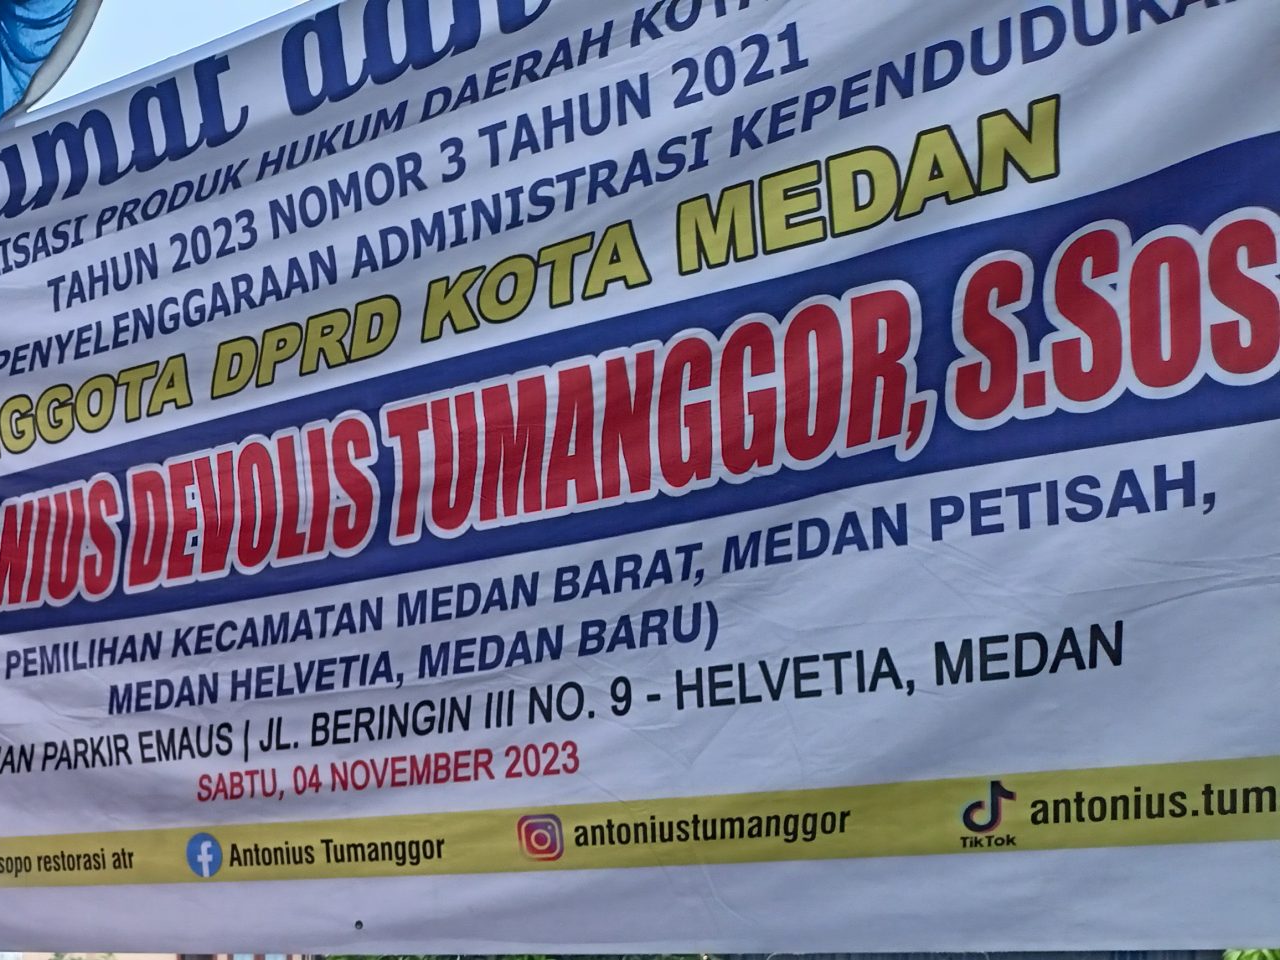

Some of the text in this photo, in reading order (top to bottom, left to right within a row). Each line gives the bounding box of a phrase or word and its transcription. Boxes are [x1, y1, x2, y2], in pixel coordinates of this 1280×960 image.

[47, 21, 809, 313] TAHUN 2023 NOMOR 3 TAHUN 2021
[96, 158, 249, 239] PRODUK
[256, 101, 408, 182] HUKUM
[419, 20, 614, 123] DAERAH
[630, 0, 768, 48] KO
[351, 126, 712, 279] ADMINISTRASI
[730, 0, 1237, 158] KEPENDUDUK
[210, 295, 401, 399] DPRD
[420, 219, 652, 343] KOTA
[676, 93, 1061, 276] MEDAN
[125, 411, 377, 593] DEVOLIS
[382, 281, 937, 544] TUMANGGOR,
[946, 207, 1280, 429] S.SOS
[5, 631, 163, 680] PEMILIHAN
[171, 597, 383, 658] KECAMATAN
[396, 571, 539, 628] MEDAN
[553, 542, 705, 604] BARAT,
[721, 502, 908, 574] MEDAN
[930, 460, 1216, 541] PETISAH,
[42, 733, 132, 771] PARKIR
[139, 722, 233, 764] EMAUS
[259, 716, 299, 752] JL.
[311, 695, 471, 747] BERINGIN
[484, 688, 514, 729] III
[528, 681, 595, 724] NO.
[610, 676, 632, 716] 9
[676, 647, 915, 711] HELVETIA,
[935, 620, 1123, 686] MEDAN
[108, 600, 719, 715] MEDAN HELVETIA, MEDAN BARU)
[197, 740, 580, 802] SABTU, 04 NOVEMBER 2023
[574, 809, 851, 848] antoniustumanggor
[1030, 784, 1277, 826] antonius.tum
[37, 847, 107, 873] restorasi
[113, 848, 134, 870] atr
[229, 838, 445, 867] Antonius Tumanggor
[960, 834, 1017, 848] TikTok
